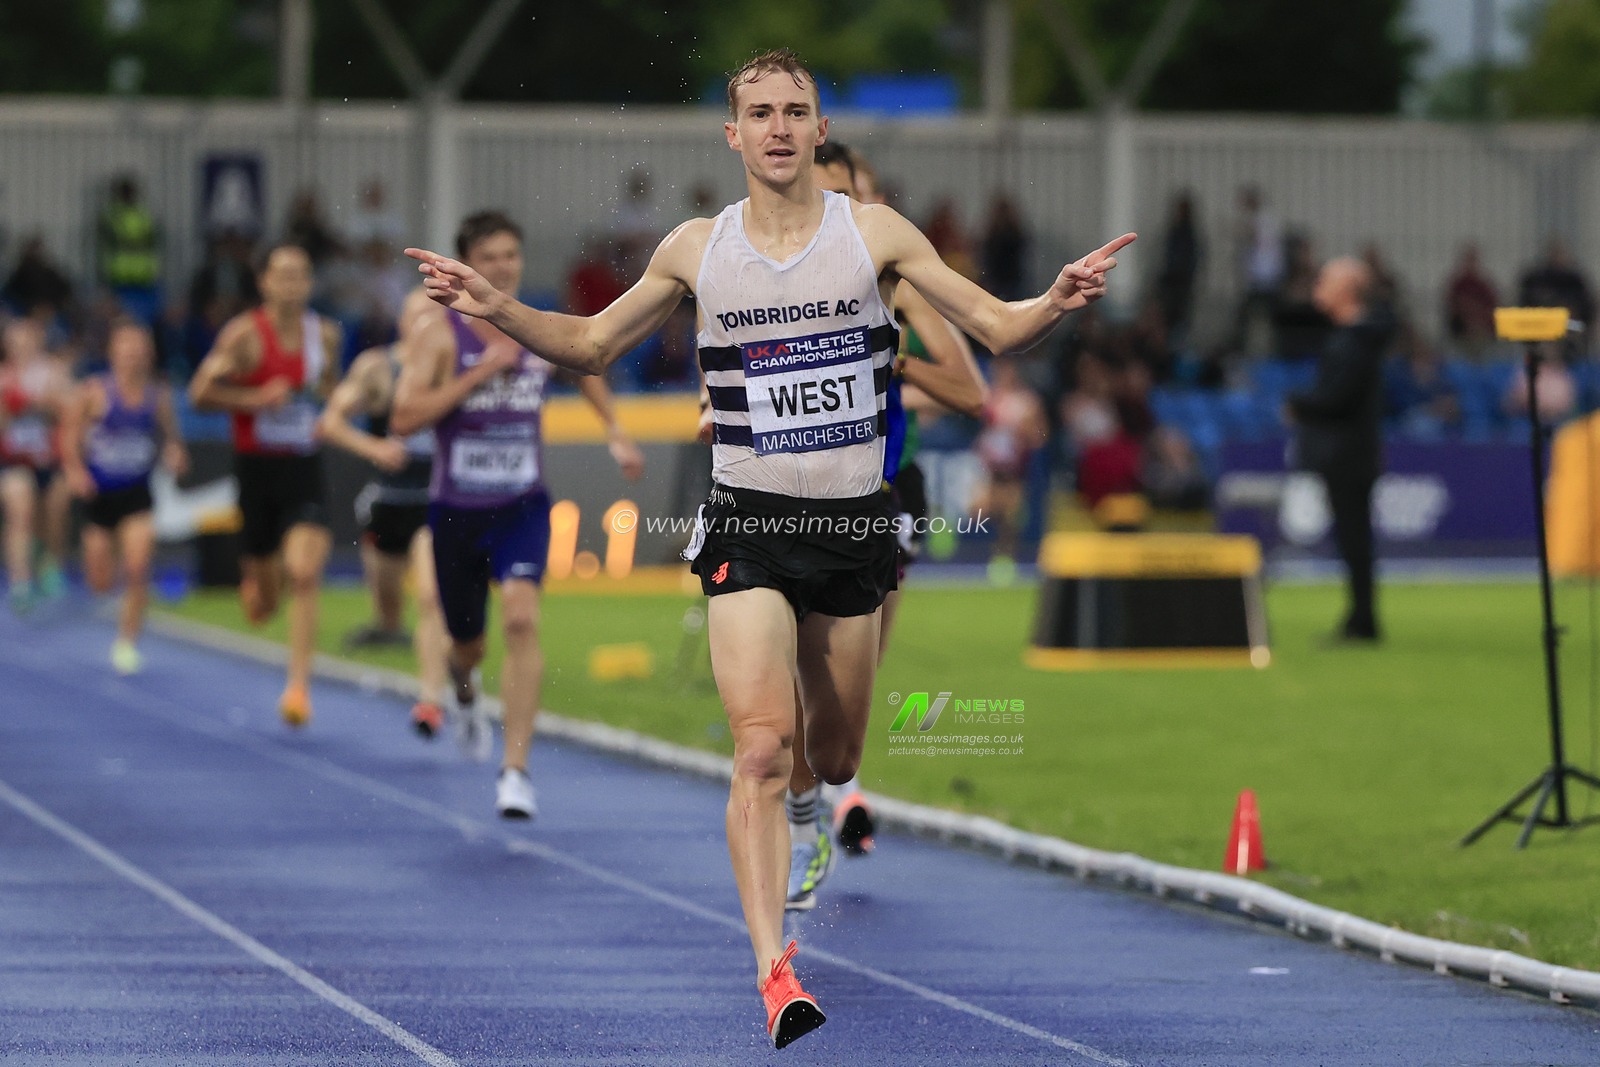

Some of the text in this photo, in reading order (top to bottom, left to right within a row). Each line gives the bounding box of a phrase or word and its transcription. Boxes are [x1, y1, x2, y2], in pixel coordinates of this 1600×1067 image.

[717, 299, 860, 332] TONBRIDGE AC
[747, 331, 864, 359] UK ATHLETICS
[750, 343, 866, 370] CHAMPIONSHIPS
[768, 374, 857, 418] WEST
[762, 421, 873, 451] MANCHESTER
